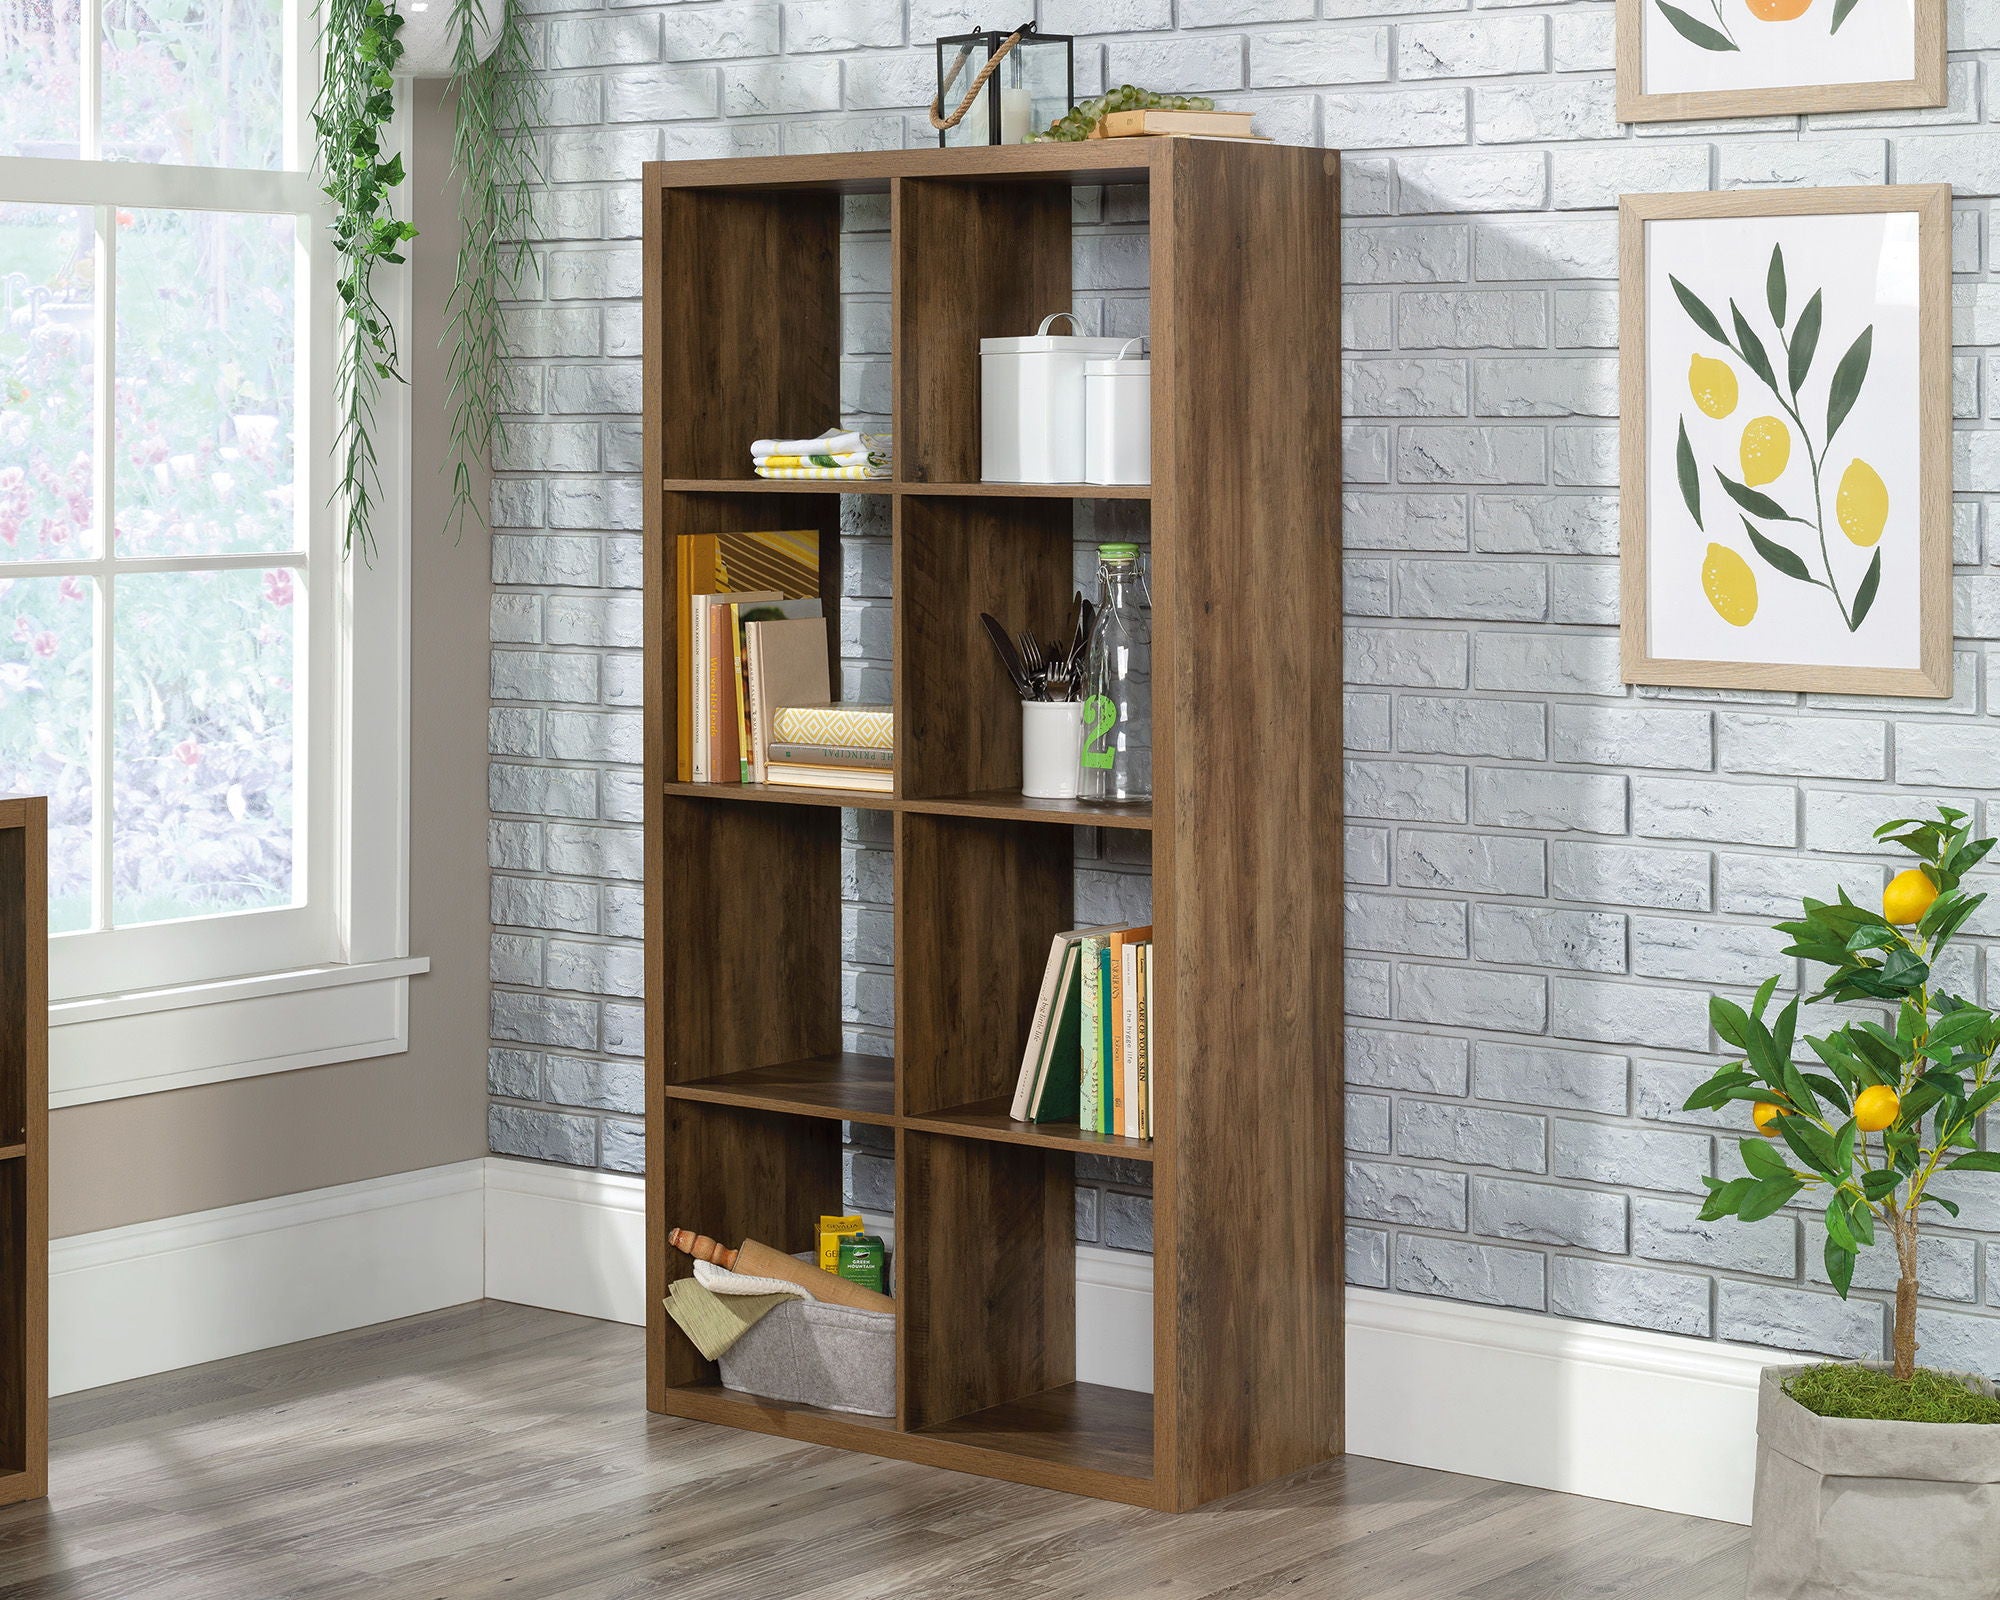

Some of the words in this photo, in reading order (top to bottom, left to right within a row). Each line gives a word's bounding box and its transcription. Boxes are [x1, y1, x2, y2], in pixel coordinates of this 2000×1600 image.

[711, 693, 718, 706] He
[1081, 694, 1117, 770] 2
[822, 748, 876, 760] PRINCIPAL
[881, 752, 893, 761] HE
[1040, 1002, 1049, 1013] big
[1037, 1013, 1047, 1030] little
[1033, 1030, 1042, 1042] life
[1139, 1024, 1145, 1036] OF
[825, 1249, 838, 1258] GE
